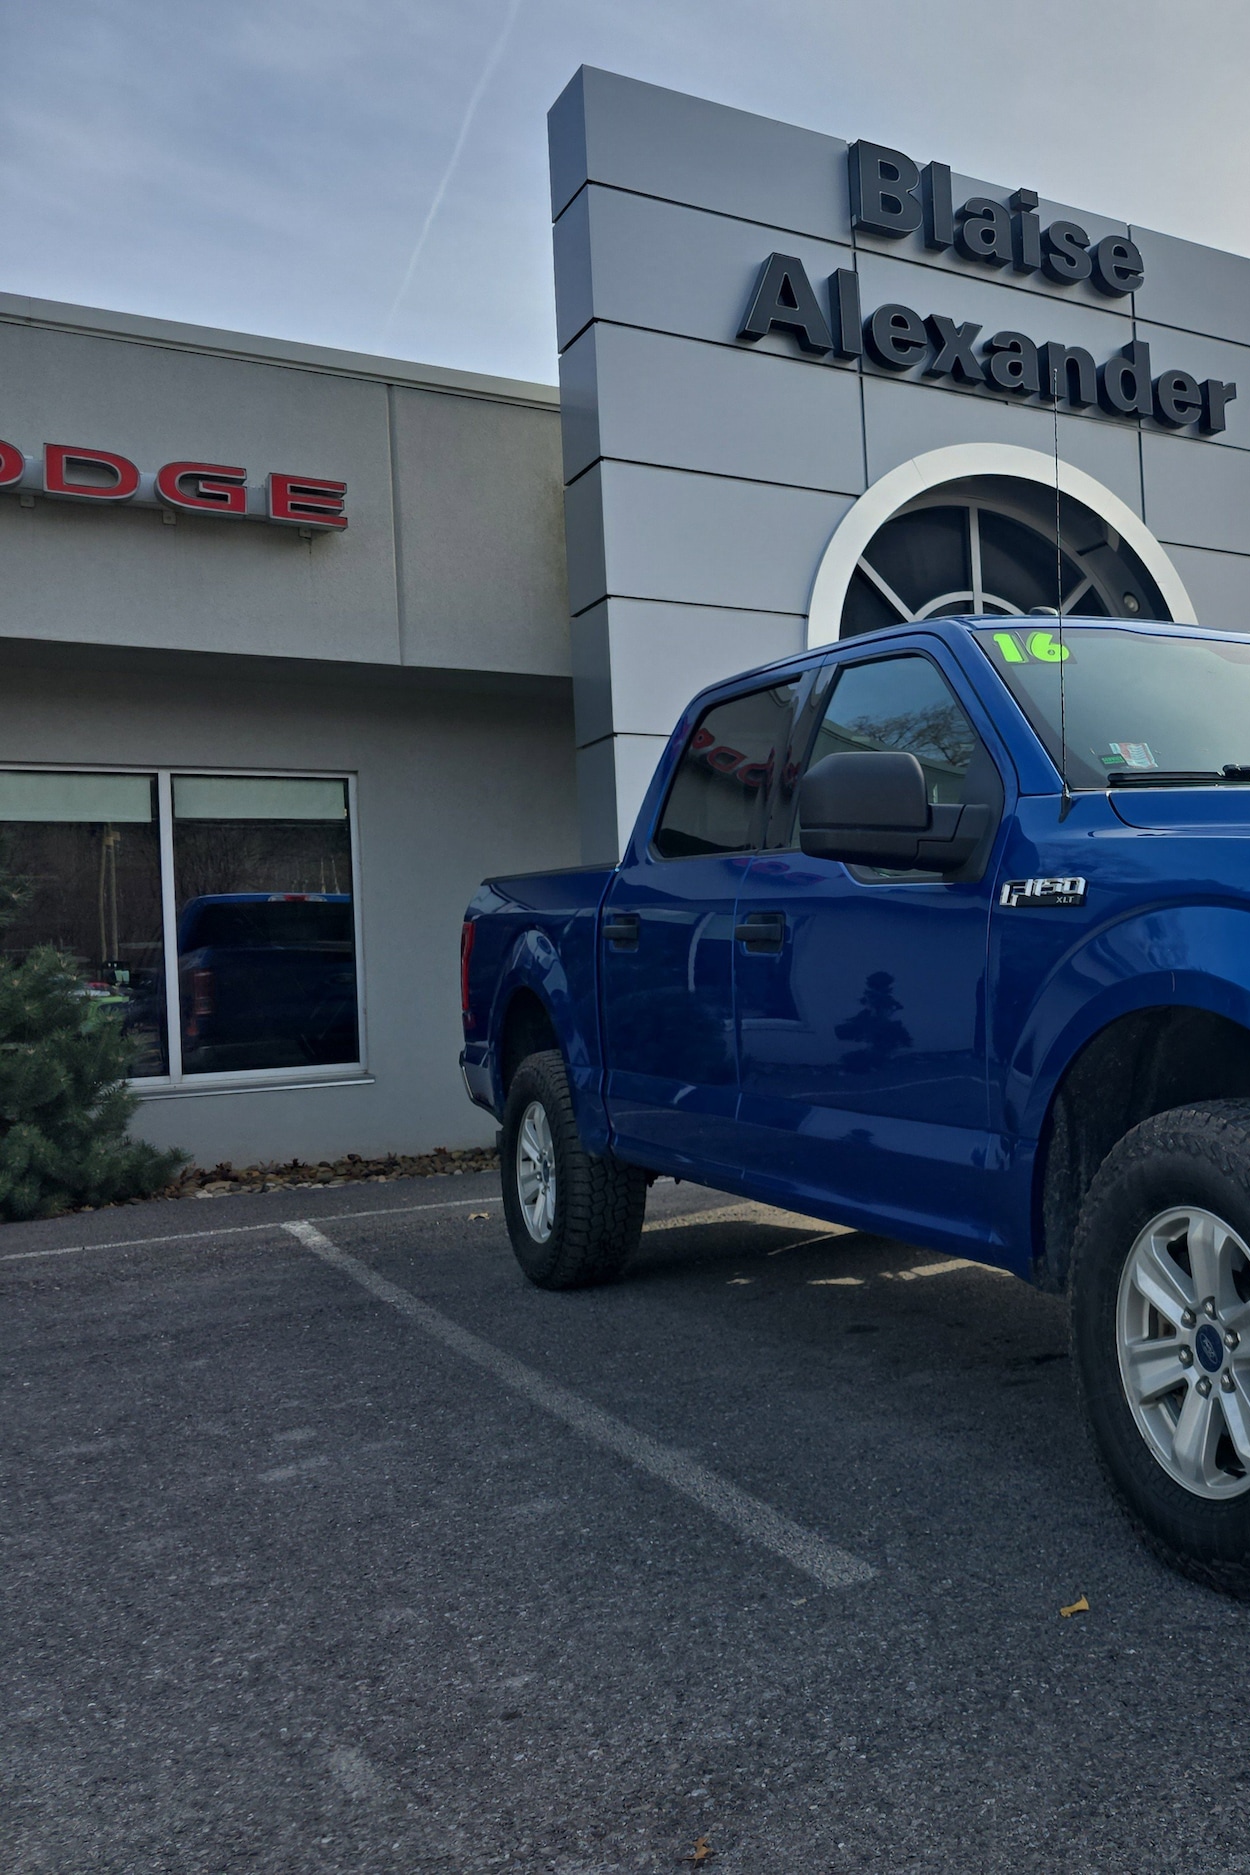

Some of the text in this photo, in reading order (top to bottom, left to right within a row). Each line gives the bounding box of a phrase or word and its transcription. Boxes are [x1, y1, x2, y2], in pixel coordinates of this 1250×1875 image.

[848, 139, 1145, 298] Blaise
[736, 252, 1236, 435] Alexander
[0, 440, 348, 531] DGE
[993, 632, 1070, 662] 16
[1055, 896, 1075, 904] XLT
